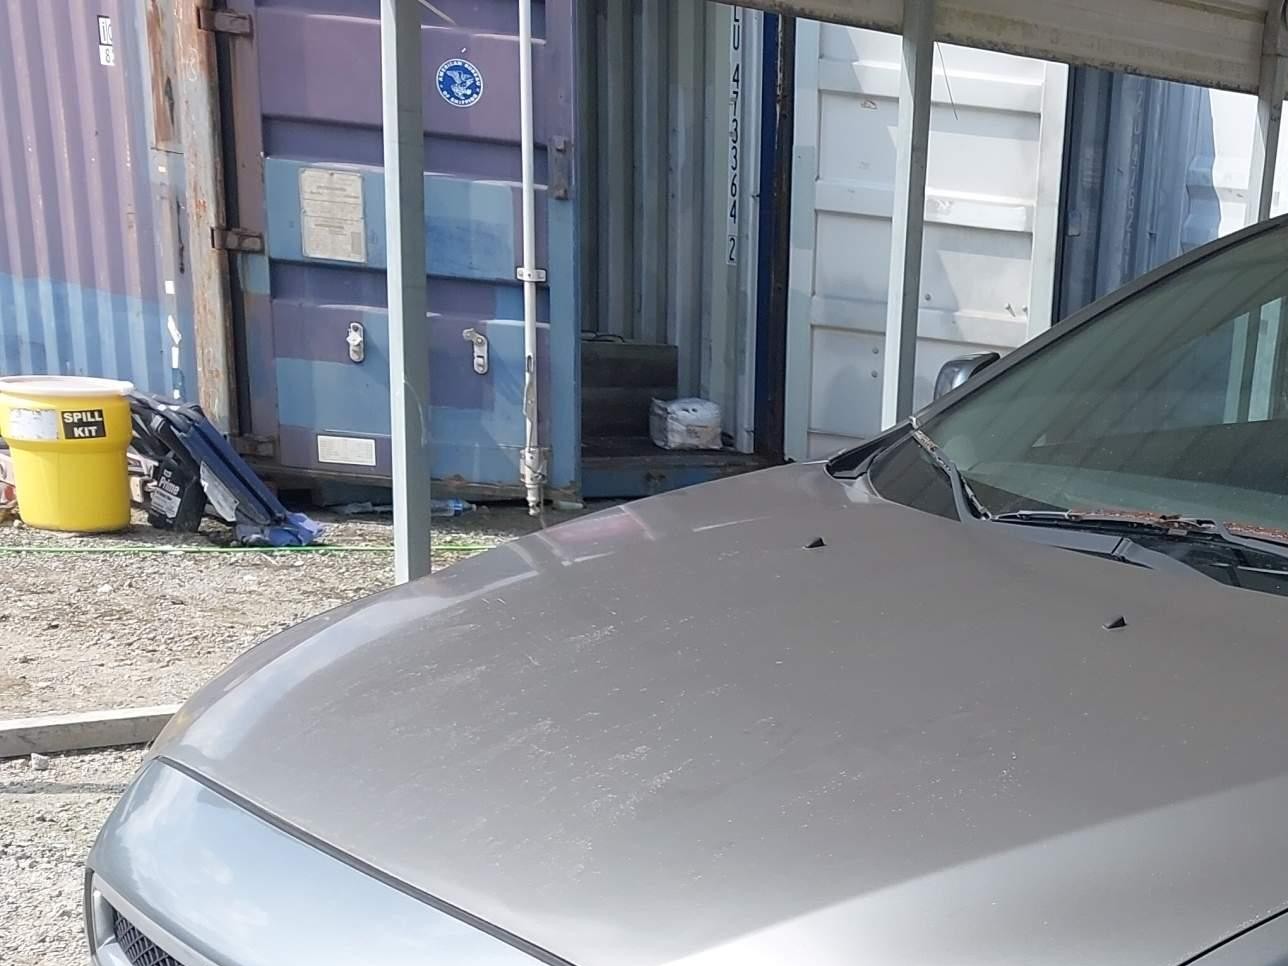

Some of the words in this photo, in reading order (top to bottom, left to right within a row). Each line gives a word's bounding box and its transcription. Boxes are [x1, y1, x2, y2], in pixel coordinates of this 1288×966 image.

[729, 237, 737, 261] 2
[63, 411, 103, 423] SPILL
[73, 426, 98, 438] KIT
[158, 476, 180, 496] Prime
